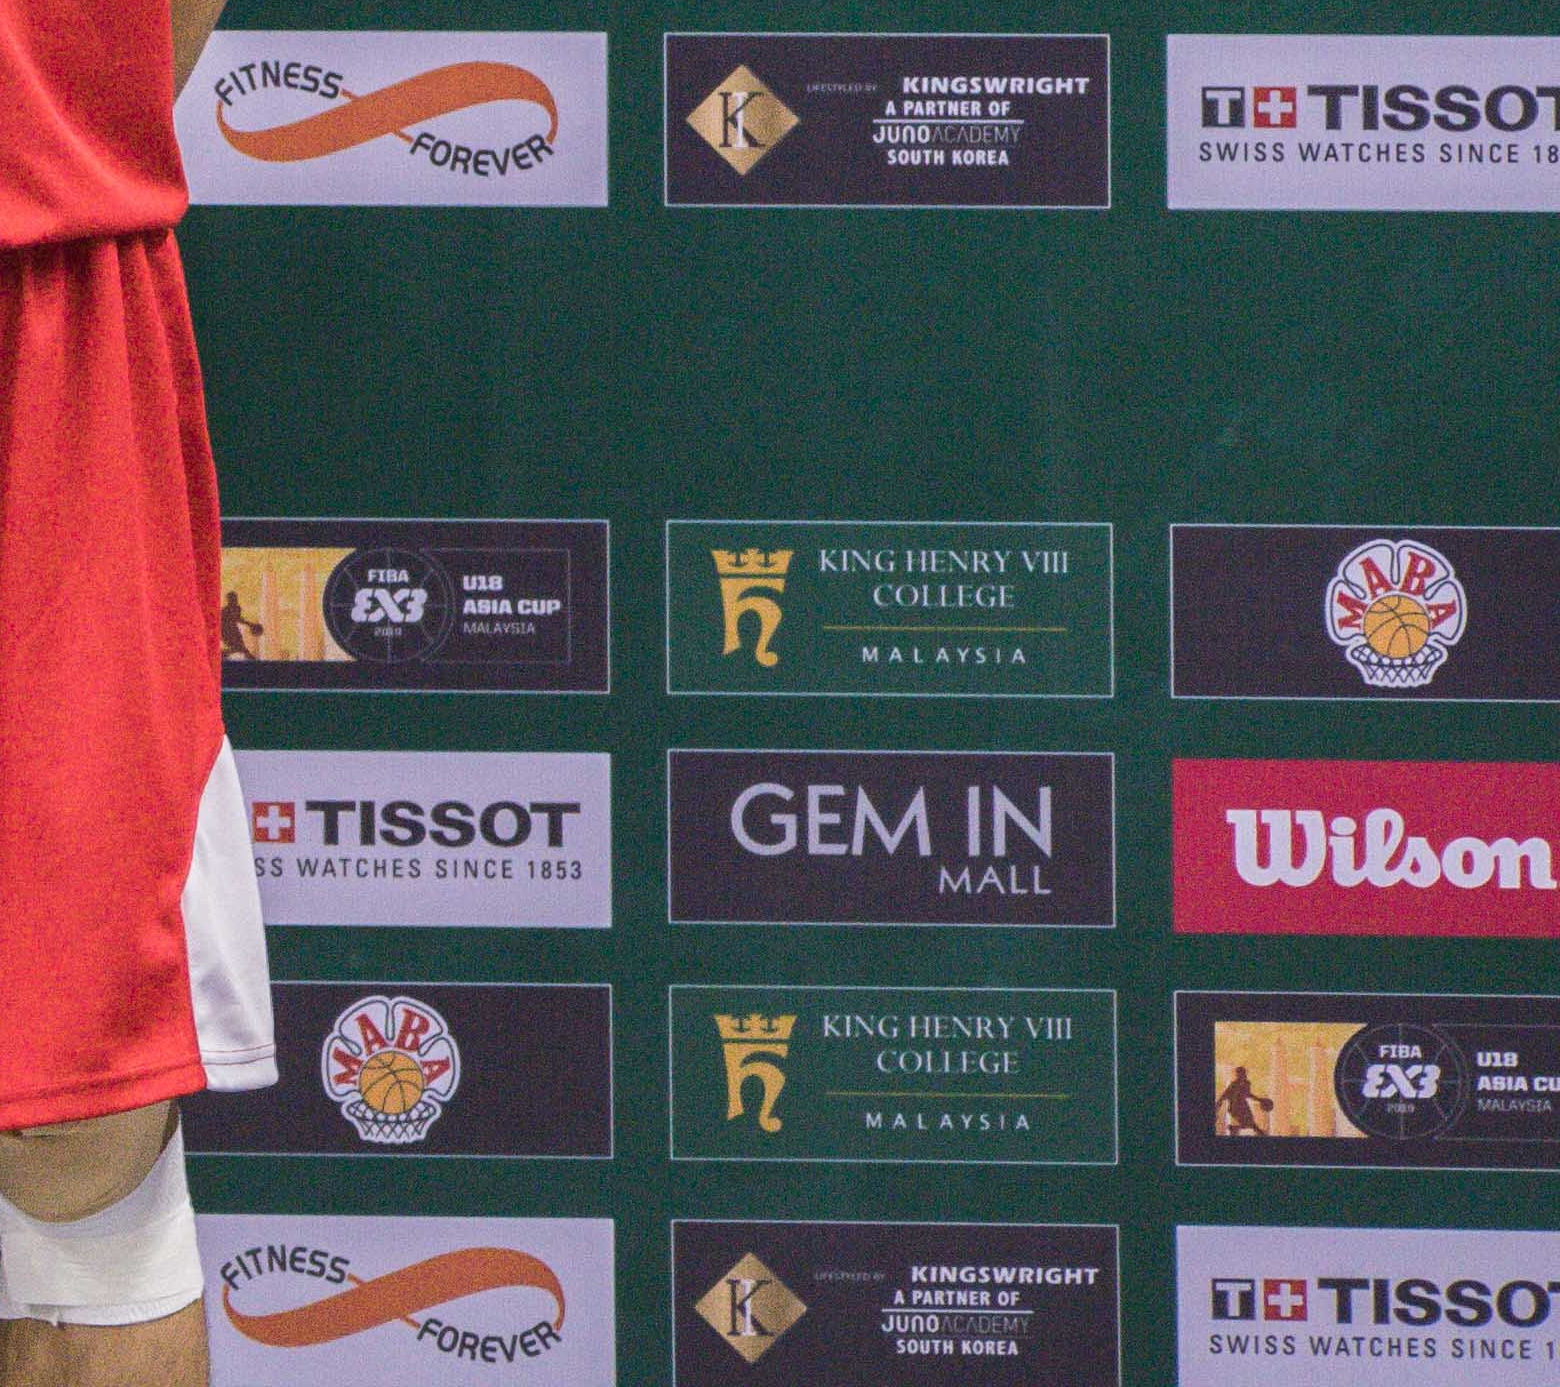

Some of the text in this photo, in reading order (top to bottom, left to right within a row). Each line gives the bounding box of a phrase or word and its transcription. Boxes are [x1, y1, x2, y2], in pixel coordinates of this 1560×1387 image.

[212, 60, 344, 107] FITNESS
[904, 77, 1089, 94] KINGSWRIGHT
[886, 101, 1009, 116] A PARTNER OF
[412, 131, 556, 179] FOREVER
[888, 149, 1008, 165] SOUTH KOREA
[1199, 142, 1518, 163] SWISS WATCHES SINCE
[1337, 554, 1455, 633] MABA
[306, 801, 580, 847] TISSOT
[731, 783, 1051, 857] GEM IN
[939, 865, 1051, 894] MALL
[823, 1014, 1072, 1040] KING HENRY VIII
[334, 1009, 450, 1088] MABA
[876, 1050, 1017, 1074] COLLEGE
[866, 1112, 1030, 1130] MALAYSIA
[218, 1246, 350, 1292] FITNESS
[912, 1266, 1098, 1284] KINGSWRIGHT
[416, 1318, 560, 1364] FOREVER
